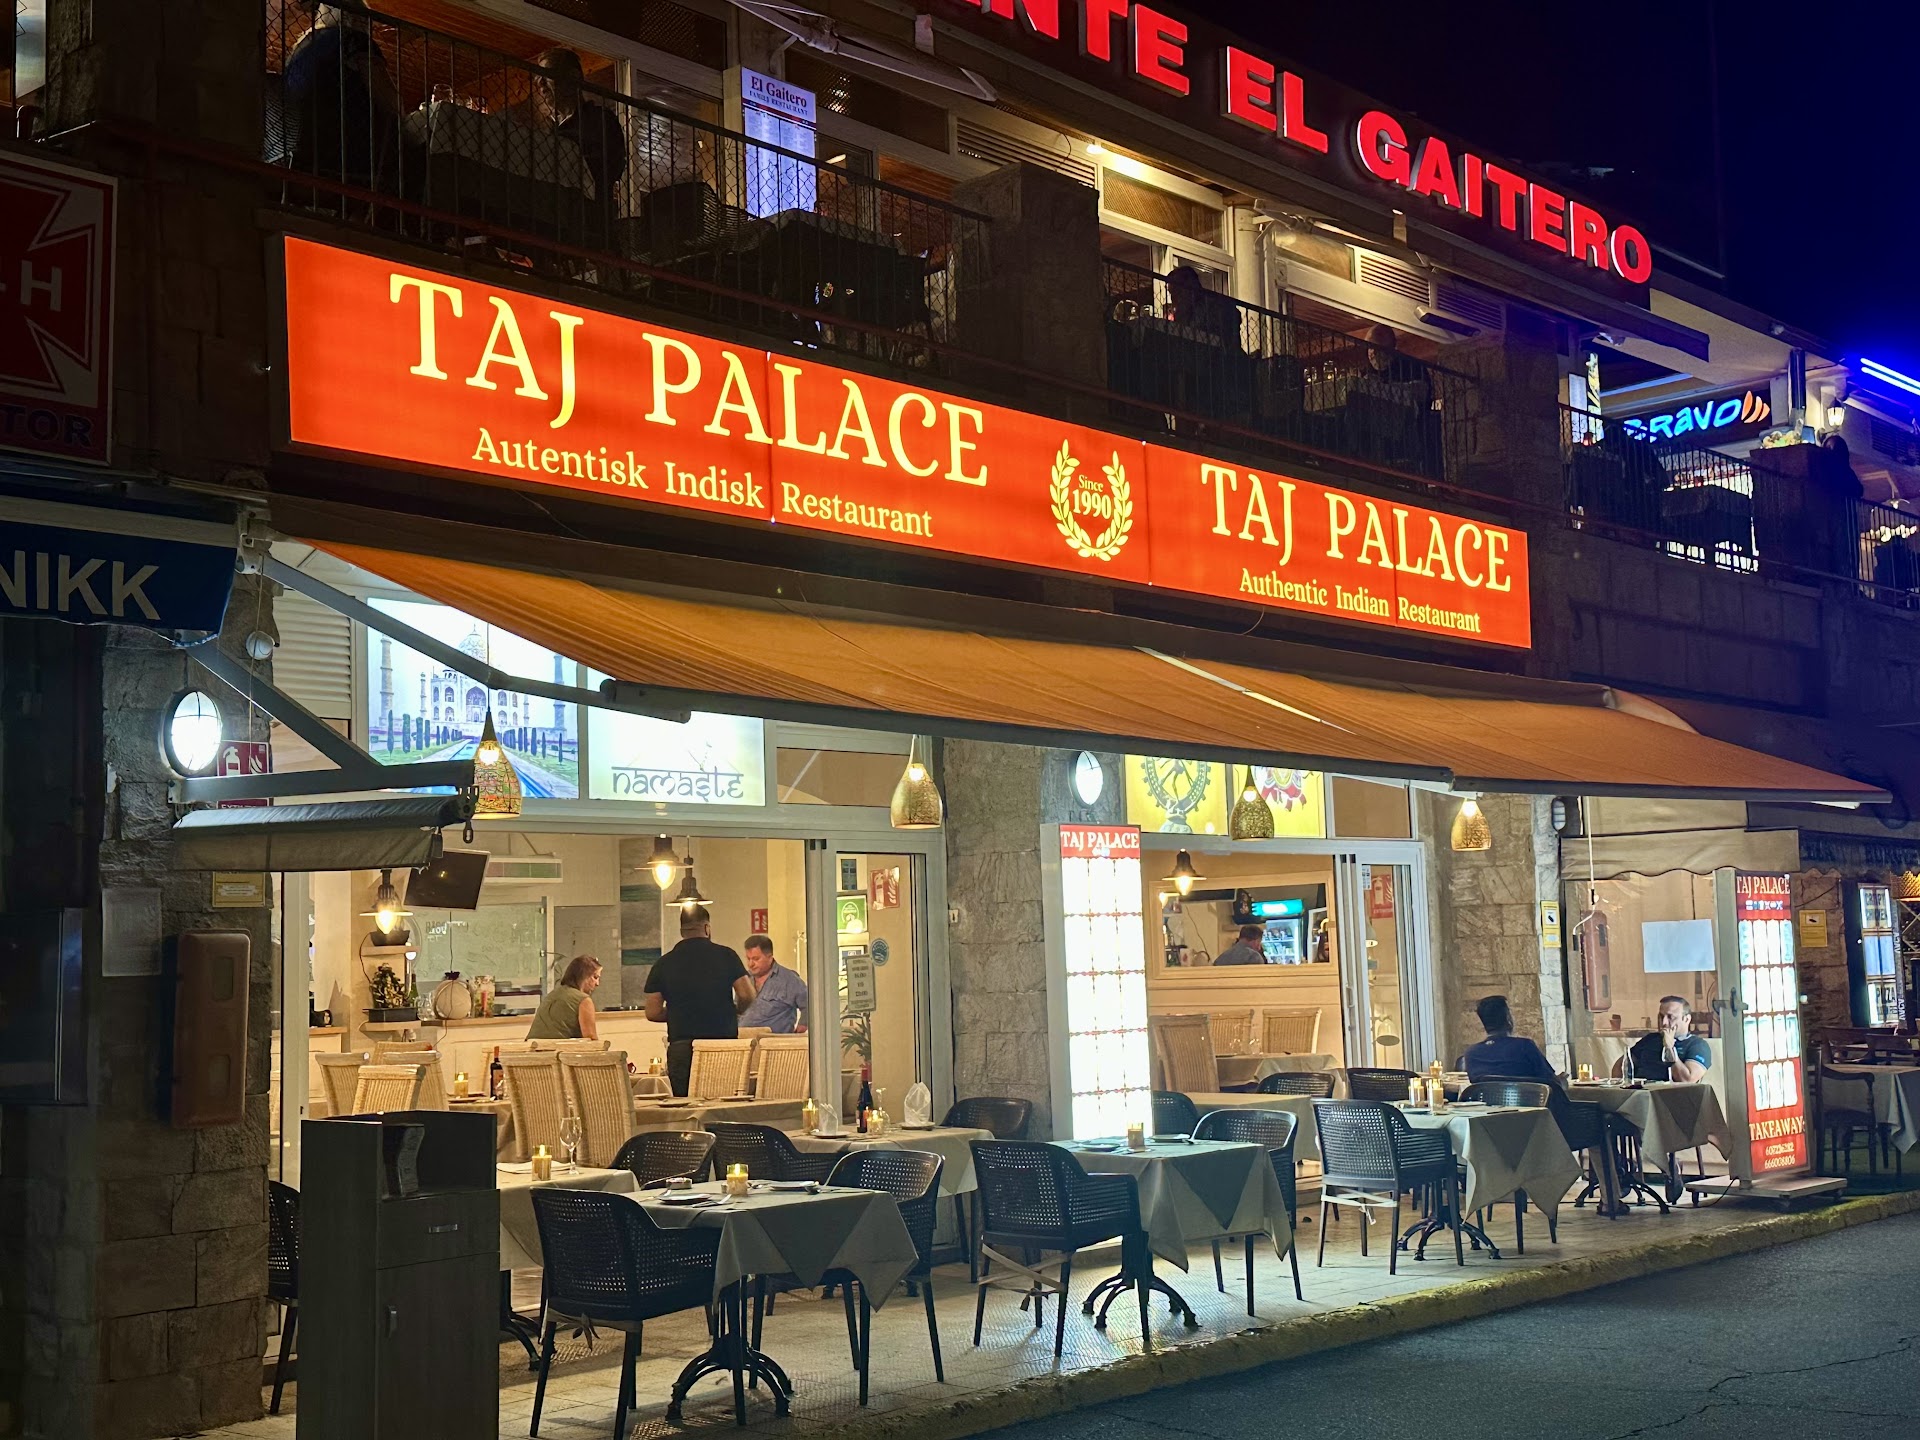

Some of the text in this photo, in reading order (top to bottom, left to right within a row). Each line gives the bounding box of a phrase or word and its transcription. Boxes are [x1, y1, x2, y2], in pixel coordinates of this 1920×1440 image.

[751, 75, 807, 108] El Gaitero
[1221, 46, 1328, 154] EL
[1357, 111, 1652, 284] GAITERO
[389, 273, 988, 487] TAJ PALACE
[472, 428, 934, 538] Autentisk Indisk Restaurant
[1078, 474, 1104, 493] Since
[1072, 489, 1112, 519] 1990
[1201, 463, 1511, 592] TAJ PALACE
[1239, 567, 1481, 634] Authentic Indian Restaurant
[611, 766, 744, 802] namaste
[1060, 831, 1139, 851] TAJ PALACE
[1737, 876, 1790, 898] TAJ PALACE
